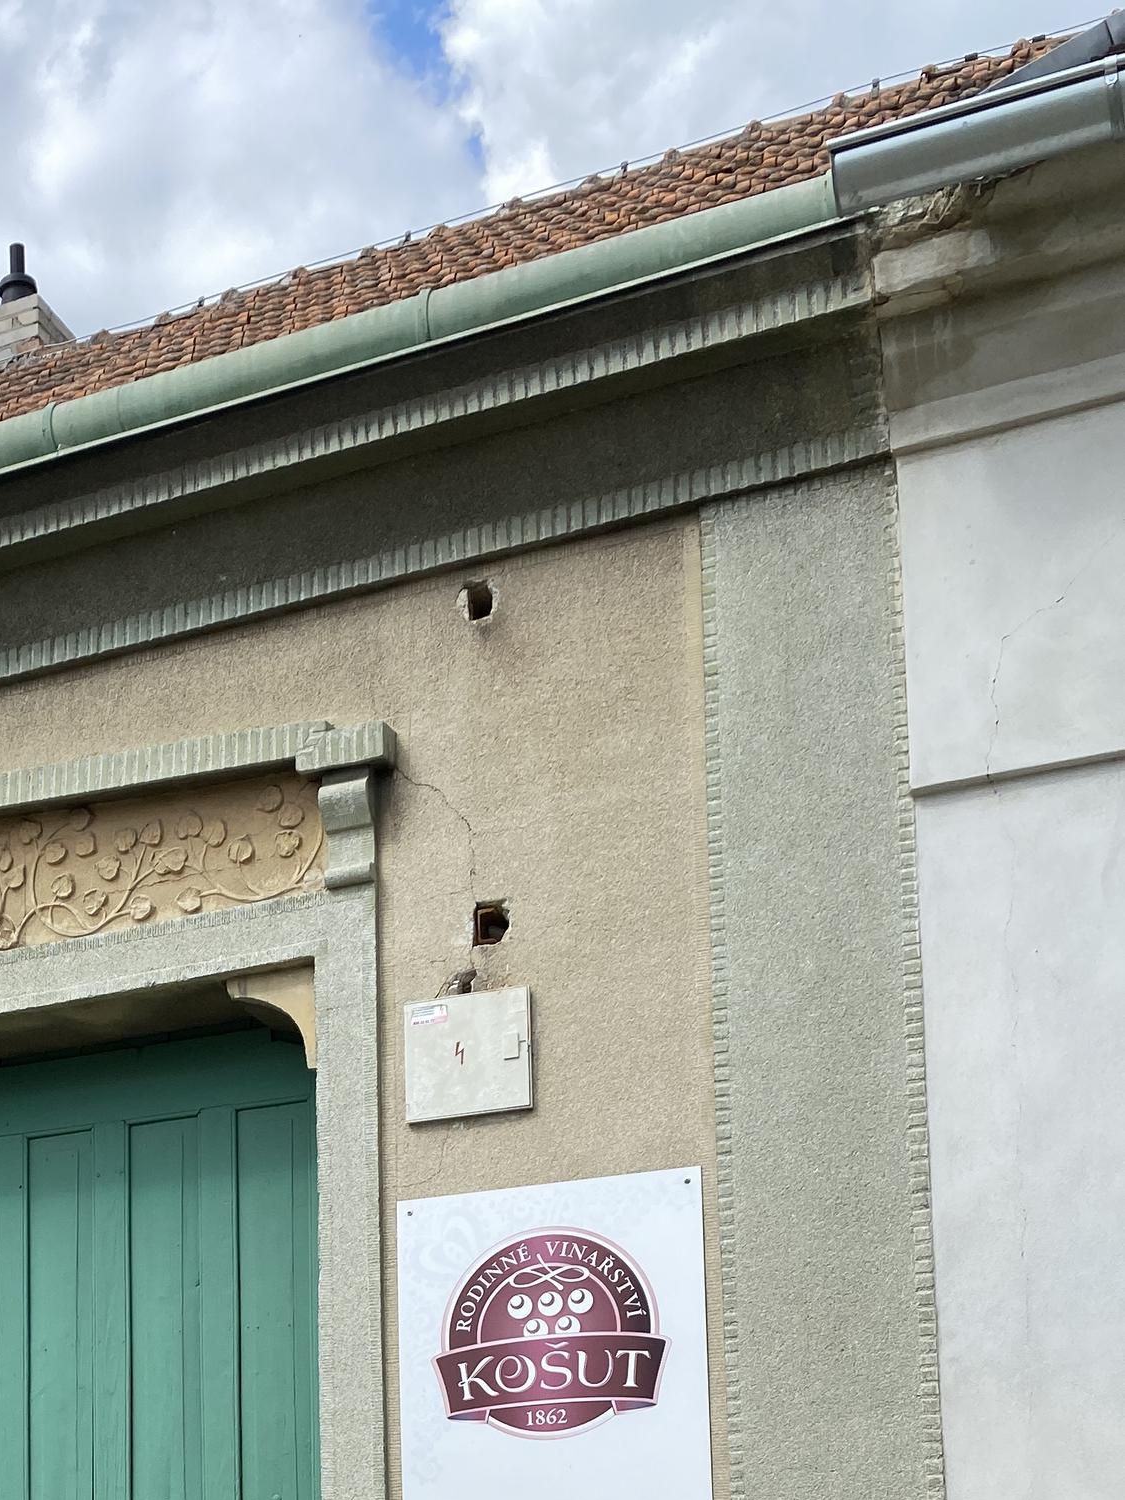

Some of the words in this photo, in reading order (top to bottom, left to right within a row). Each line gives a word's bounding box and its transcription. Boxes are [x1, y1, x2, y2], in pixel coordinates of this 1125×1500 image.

[455, 1243, 531, 1332] RODINNÉ
[545, 1240, 647, 1319] VINAŘSTVÍ
[458, 1341, 651, 1401] KOŠUT
[526, 1408, 568, 1426] 1862
